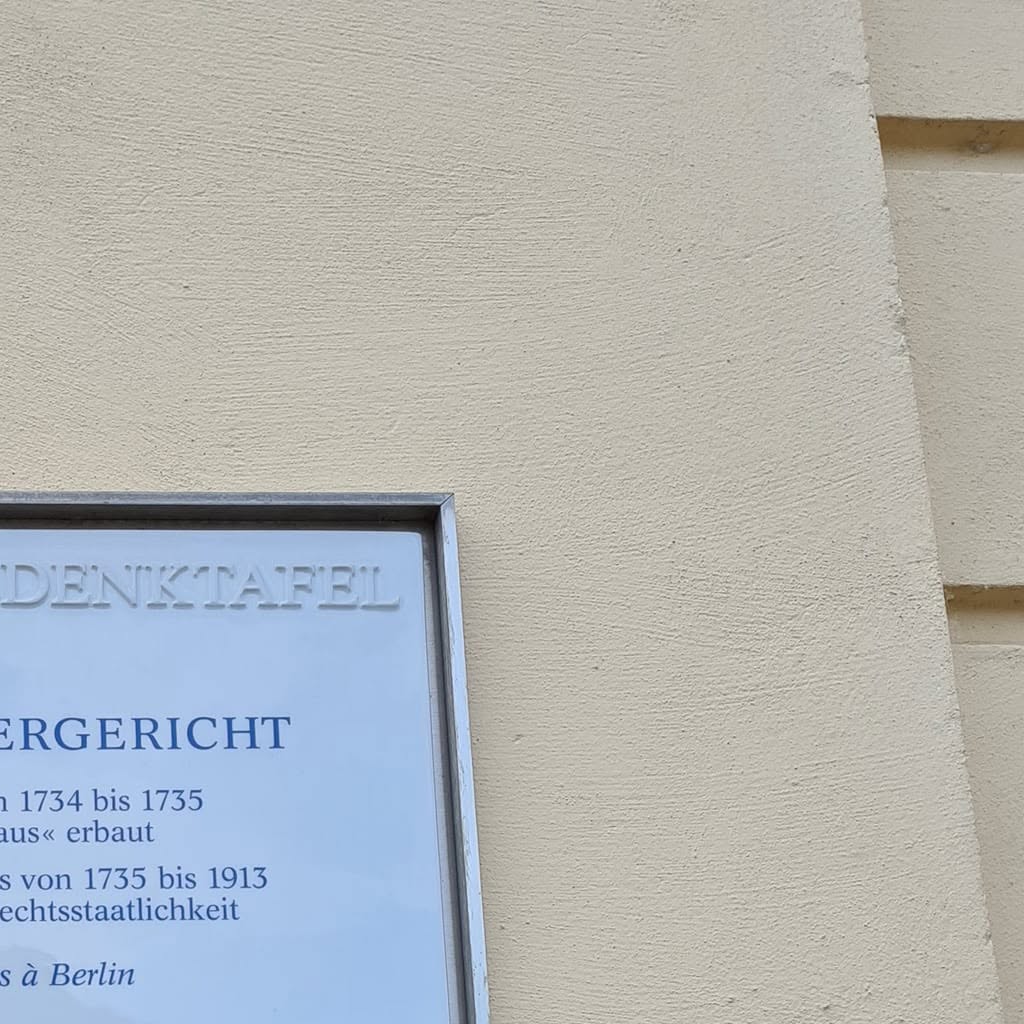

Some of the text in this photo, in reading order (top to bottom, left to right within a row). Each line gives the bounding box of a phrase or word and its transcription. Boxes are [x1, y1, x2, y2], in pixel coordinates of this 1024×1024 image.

[21, 789, 84, 813] 1734
[91, 788, 131, 812] bis
[142, 788, 203, 812] 1735
[66, 819, 155, 844] erbaut
[20, 873, 73, 891] von
[85, 866, 147, 890] 1735
[157, 865, 197, 890] bis
[208, 866, 268, 890] 1913
[21, 962, 38, 987] à
[48, 961, 135, 987] Berlin
